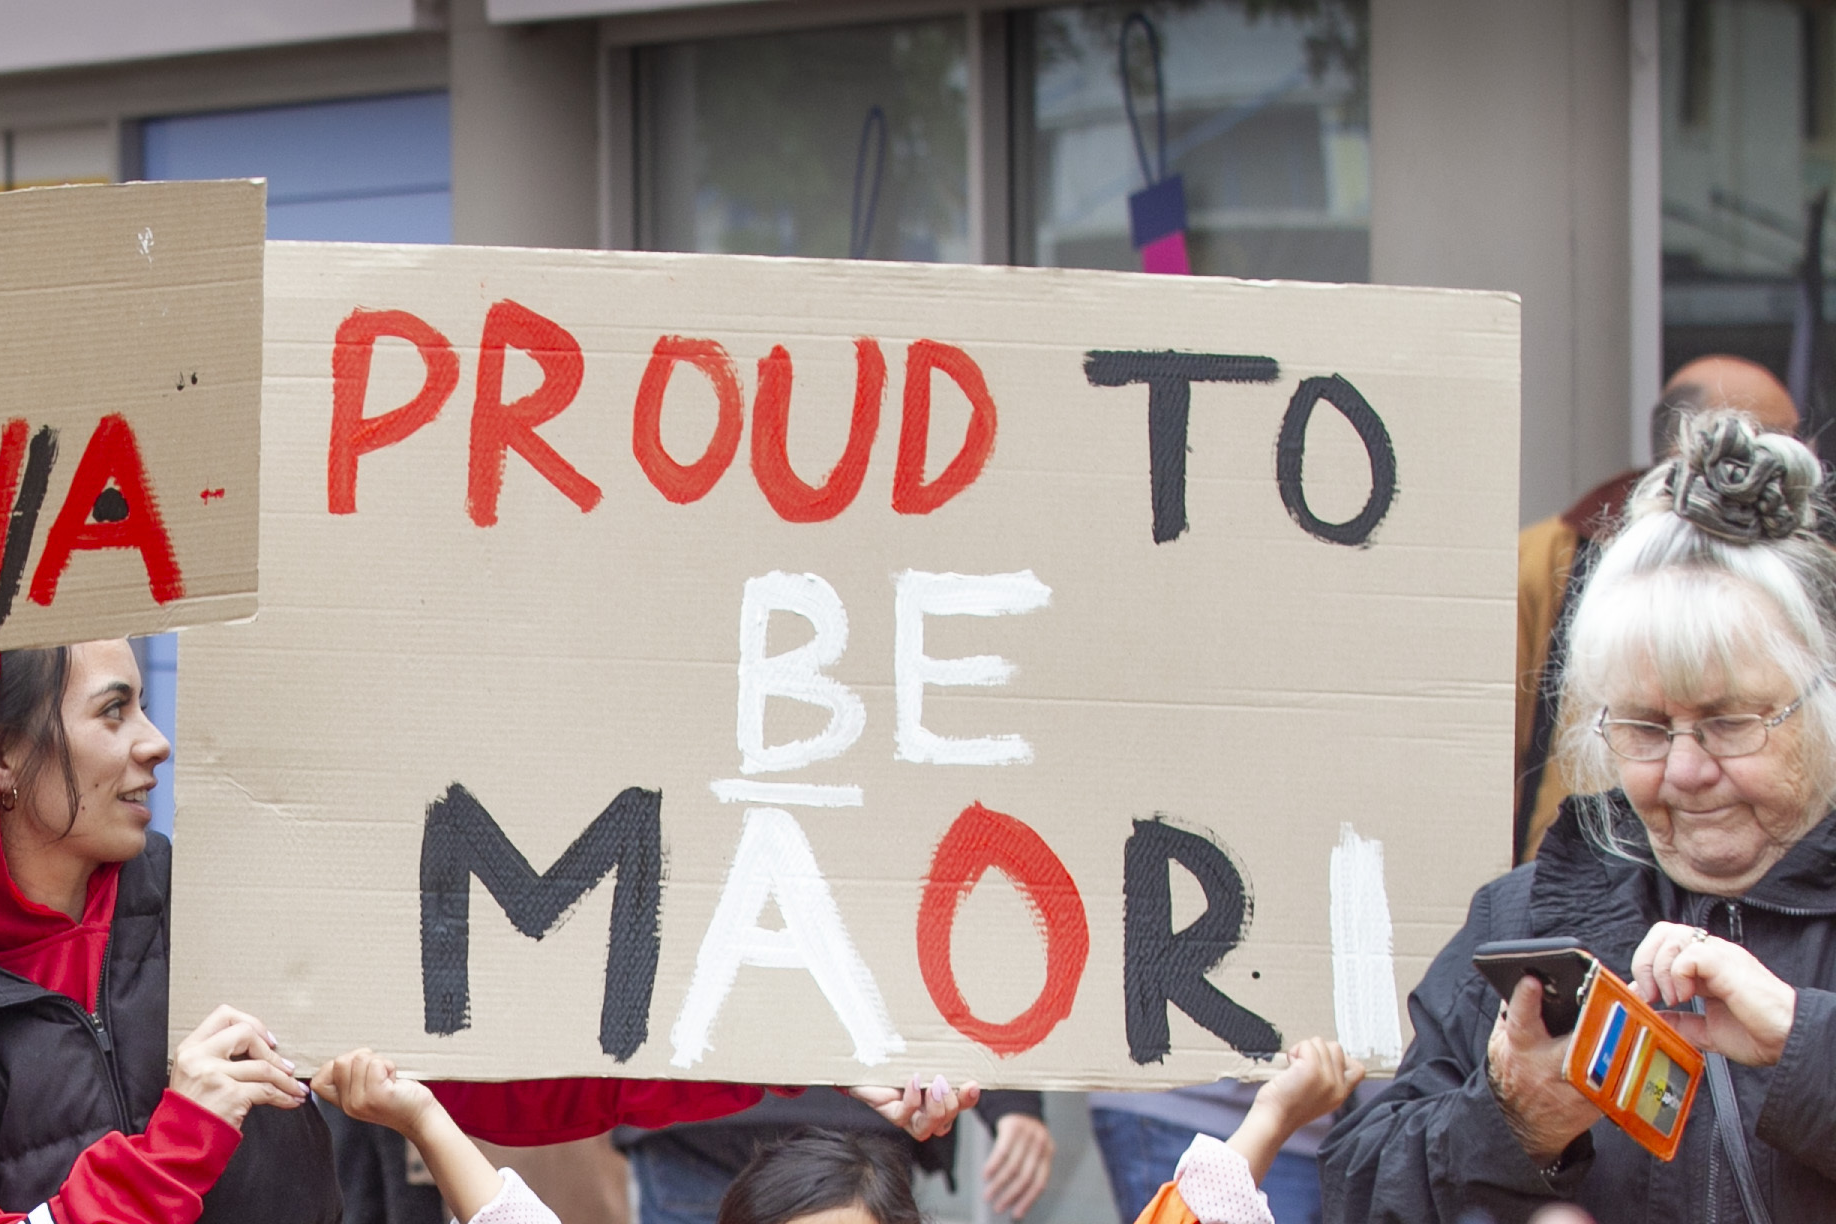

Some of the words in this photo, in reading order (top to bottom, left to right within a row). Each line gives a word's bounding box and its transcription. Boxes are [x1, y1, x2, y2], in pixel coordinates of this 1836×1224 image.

[328, 298, 998, 527] PROUD
[1083, 348, 1400, 548] TO
[737, 570, 1053, 774] BE
[419, 779, 1403, 1067] MĀORI
